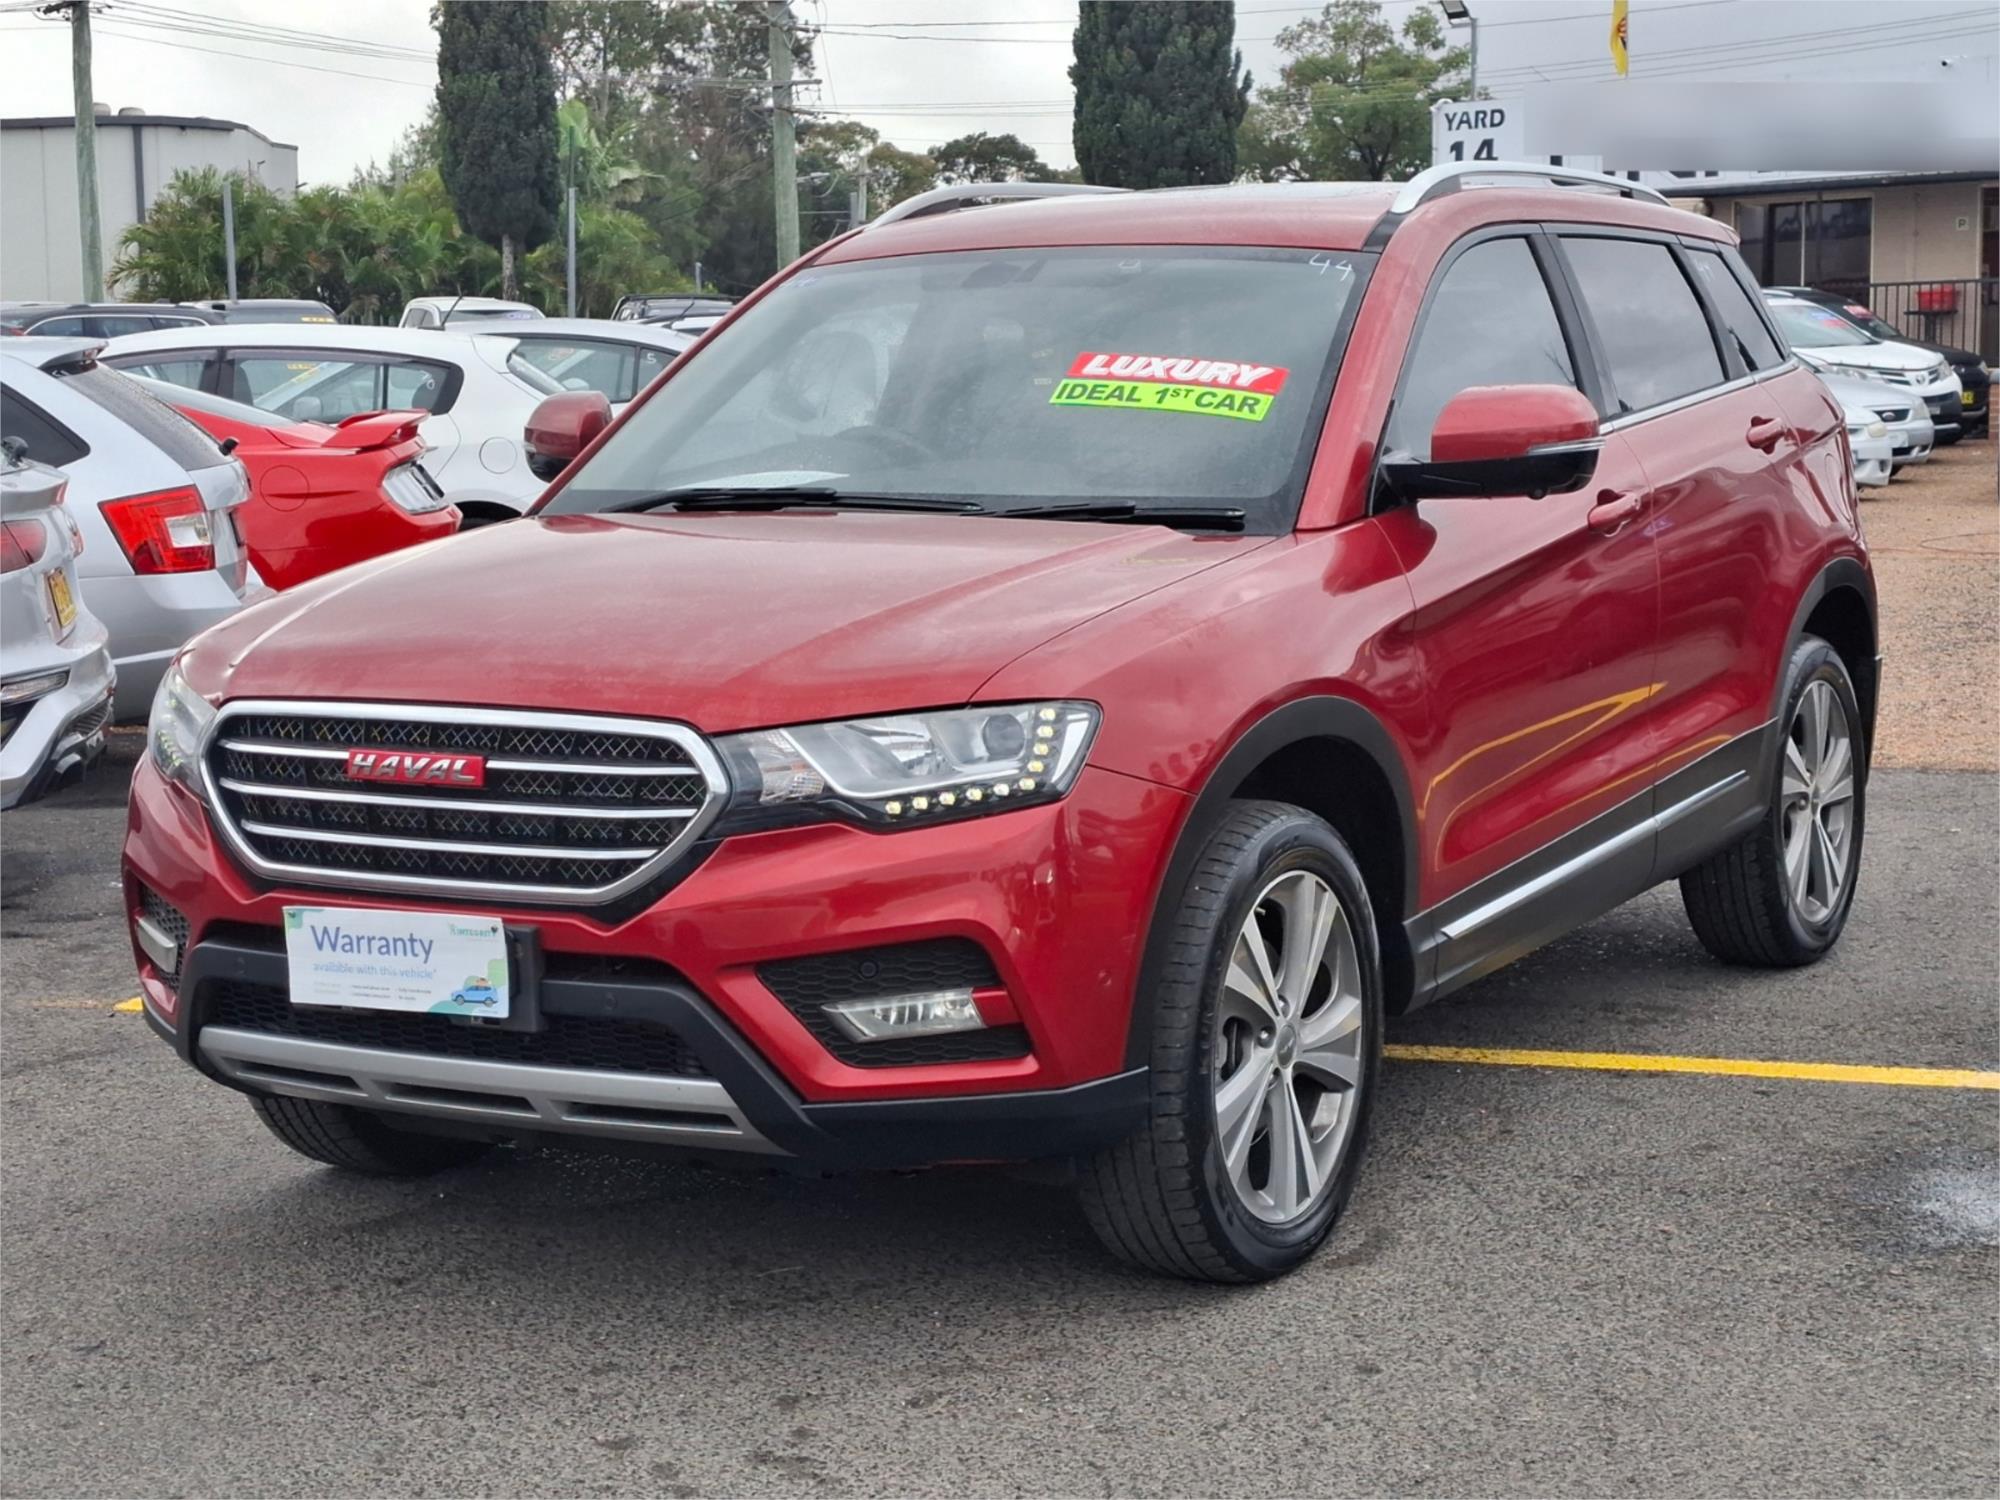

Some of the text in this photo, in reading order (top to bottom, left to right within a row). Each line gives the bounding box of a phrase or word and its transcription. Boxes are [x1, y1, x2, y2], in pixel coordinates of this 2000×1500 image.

[1444, 108, 1505, 132] YARD
[1449, 138, 1499, 161] 14
[1309, 252, 1353, 282] 44
[1080, 354, 1276, 387] LUXURY
[1055, 383, 1261, 415] IDEAL 1ST CAR
[351, 753, 477, 782] HAVAL
[309, 924, 434, 965] Warranty
